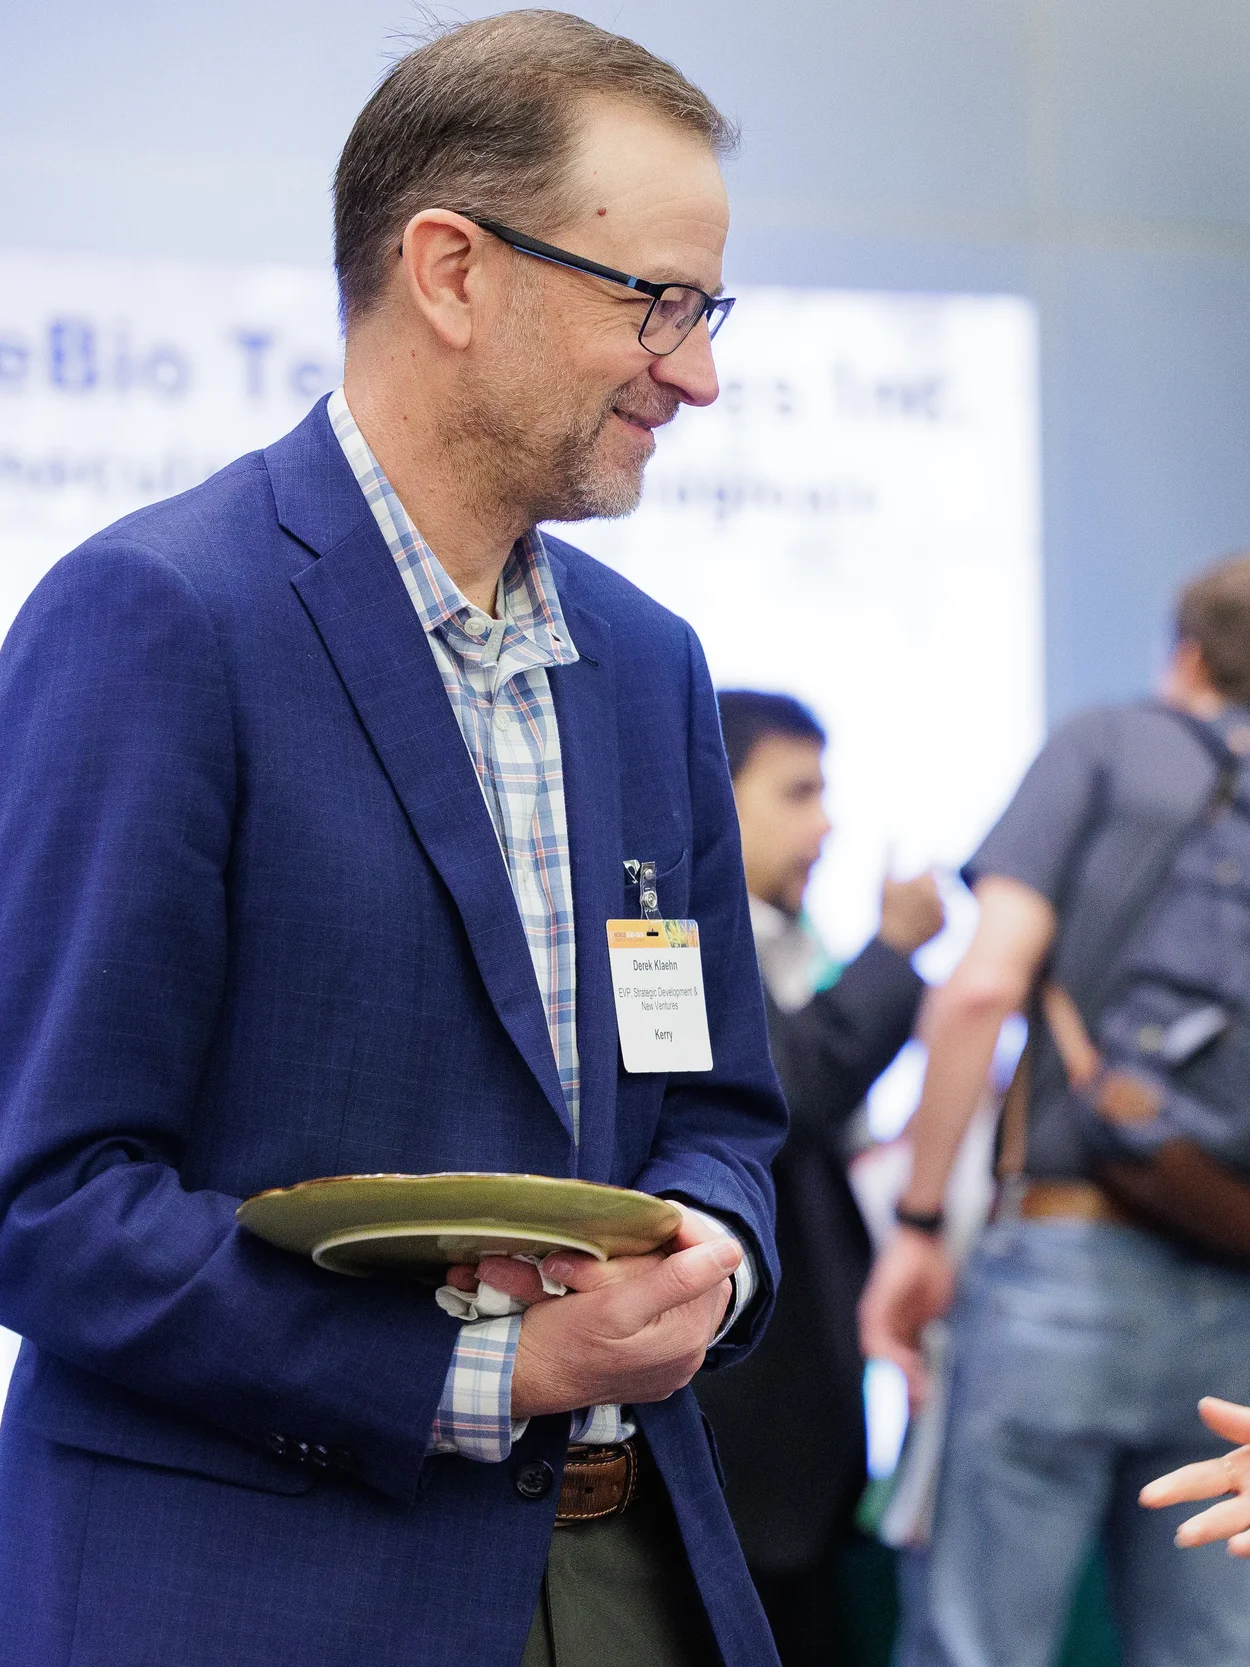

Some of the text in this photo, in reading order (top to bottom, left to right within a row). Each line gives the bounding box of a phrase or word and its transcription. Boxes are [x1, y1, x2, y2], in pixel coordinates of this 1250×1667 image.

[632, 959, 678, 971] Derek Klaehn
[634, 988, 657, 1000] Strategic
[658, 987, 692, 999] Development
[694, 986, 698, 996] &
[642, 1001, 678, 1011] New Ventures
[655, 1029, 672, 1042] Kerry
